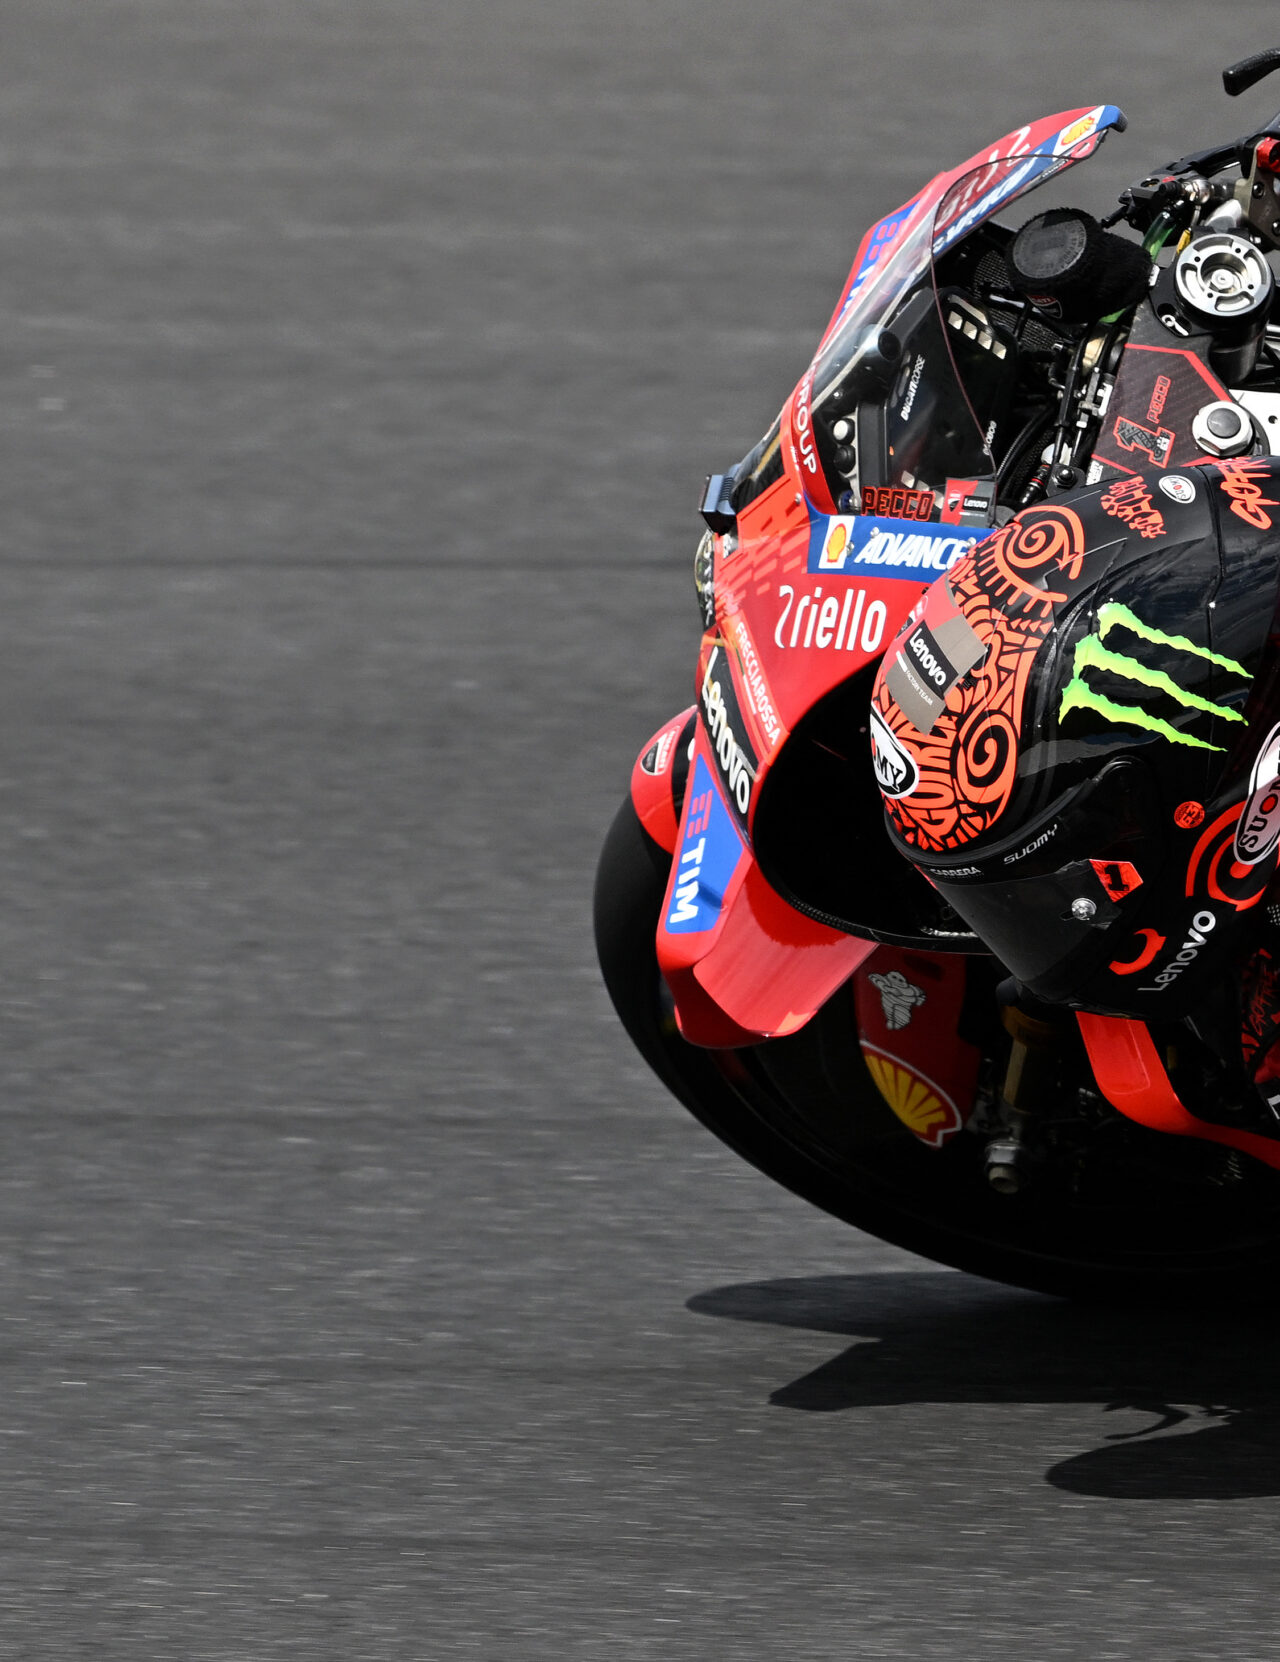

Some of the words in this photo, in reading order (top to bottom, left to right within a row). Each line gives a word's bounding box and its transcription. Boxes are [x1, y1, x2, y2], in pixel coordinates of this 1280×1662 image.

[1146, 375, 1172, 424] PECCO
[861, 485, 936, 522] PECCO
[963, 495, 989, 509] Lenovo
[909, 627, 947, 686] Lenovo
[735, 621, 782, 746] FRECCIAROSSA
[918, 689, 934, 706] TEAM
[701, 645, 750, 814] Lenovo
[1003, 824, 1059, 865] SUOMY
[669, 837, 706, 924] TIM
[1103, 864, 1130, 892] 1
[1136, 910, 1217, 991] Lenovo
